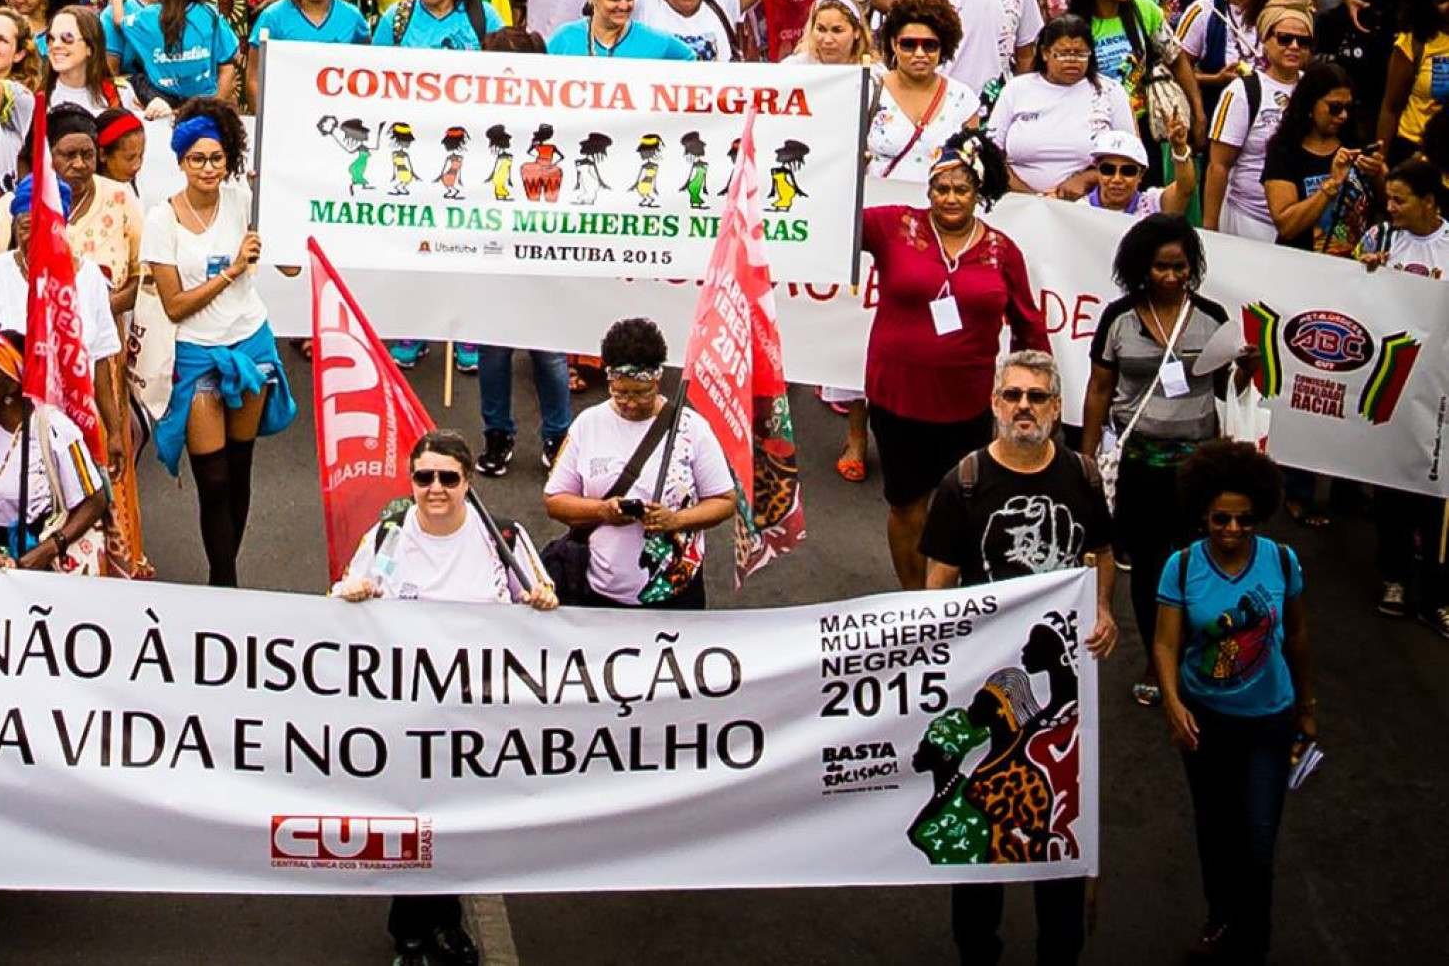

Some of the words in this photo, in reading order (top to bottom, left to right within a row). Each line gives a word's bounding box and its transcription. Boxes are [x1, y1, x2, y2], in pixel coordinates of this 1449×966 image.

[316, 66, 638, 114] CONSCIÊNCIA
[651, 84, 813, 118] NEGRA
[310, 200, 436, 230] MARCHA
[446, 208, 504, 233] DAS
[512, 211, 680, 240] MULHERES
[515, 245, 616, 265] UBATUBA
[623, 250, 674, 266] 2015
[702, 324, 761, 389] 2015
[1291, 328, 1366, 361] ABC
[1290, 394, 1346, 418] RACIAL
[820, 606, 935, 635] MARCHA
[944, 595, 999, 619] DAS
[821, 618, 974, 654] MULHERES
[130, 606, 175, 684] À
[194, 629, 743, 719] DISCRIMINAÇÃO
[821, 642, 952, 679] NEGRAS
[820, 669, 950, 719] 2015
[50, 709, 215, 771] VIDA
[233, 718, 264, 773] E
[285, 722, 388, 780] NO
[405, 719, 766, 781] TRABALHO
[822, 741, 897, 763] BASTA
[822, 760, 900, 788] RACISMO!
[272, 818, 418, 860] CUT
[419, 816, 433, 862] BRASIL
[270, 859, 309, 870] CENTRAL
[360, 860, 433, 872] TRABALHADORES
